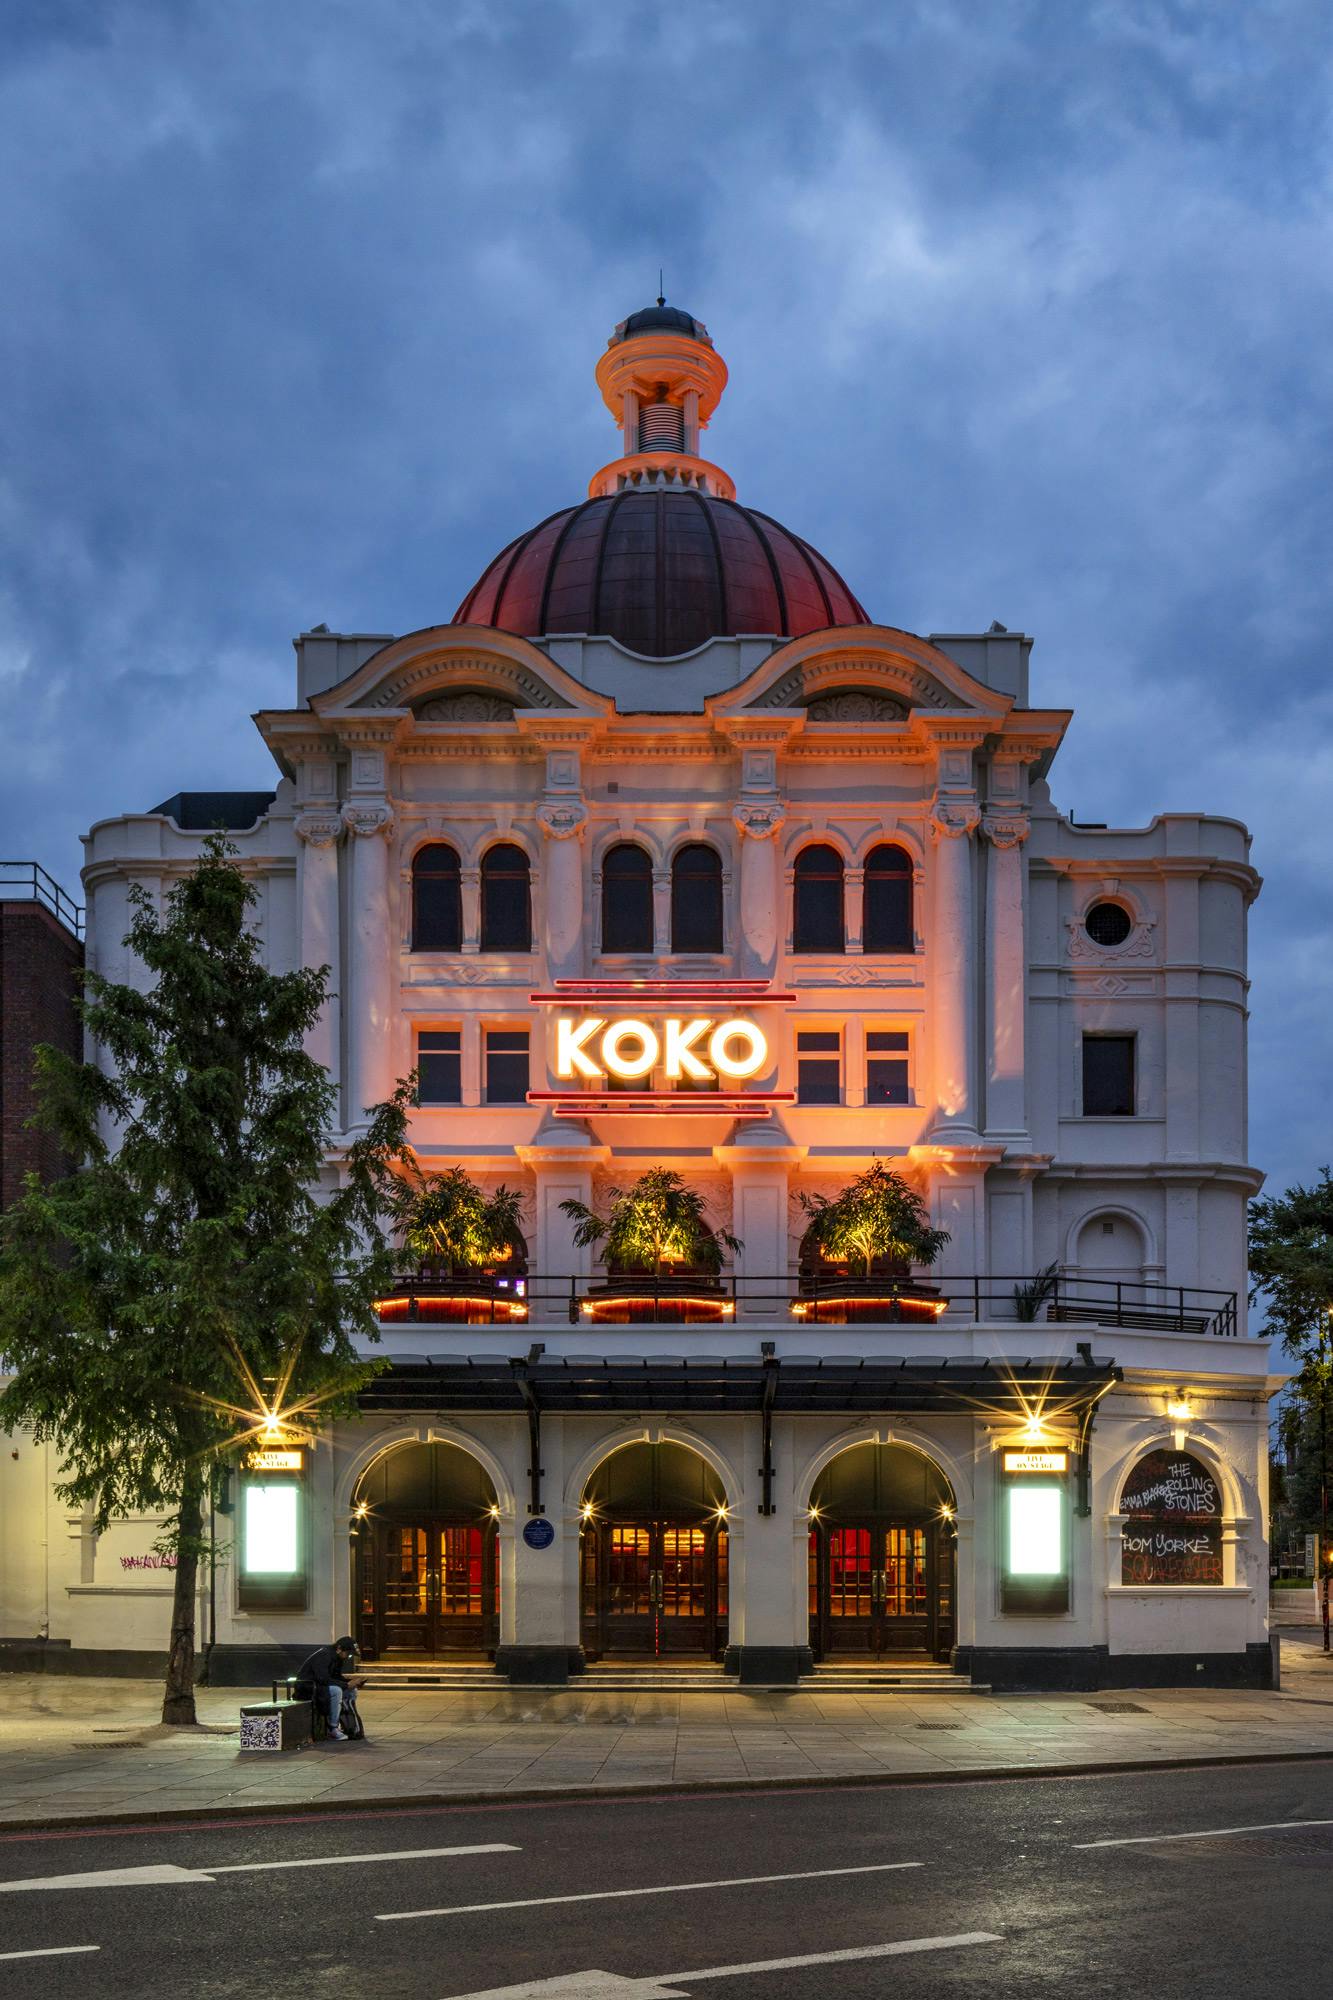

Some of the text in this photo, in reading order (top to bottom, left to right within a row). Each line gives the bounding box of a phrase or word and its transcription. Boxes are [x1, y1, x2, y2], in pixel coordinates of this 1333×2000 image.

[557, 1017, 767, 1079] KOKO
[1168, 1462, 1191, 1478] THE
[1166, 1477, 1216, 1494] ROLLING
[1164, 1492, 1216, 1513] STONES
[1123, 1534, 1214, 1557] HOM YORKE
